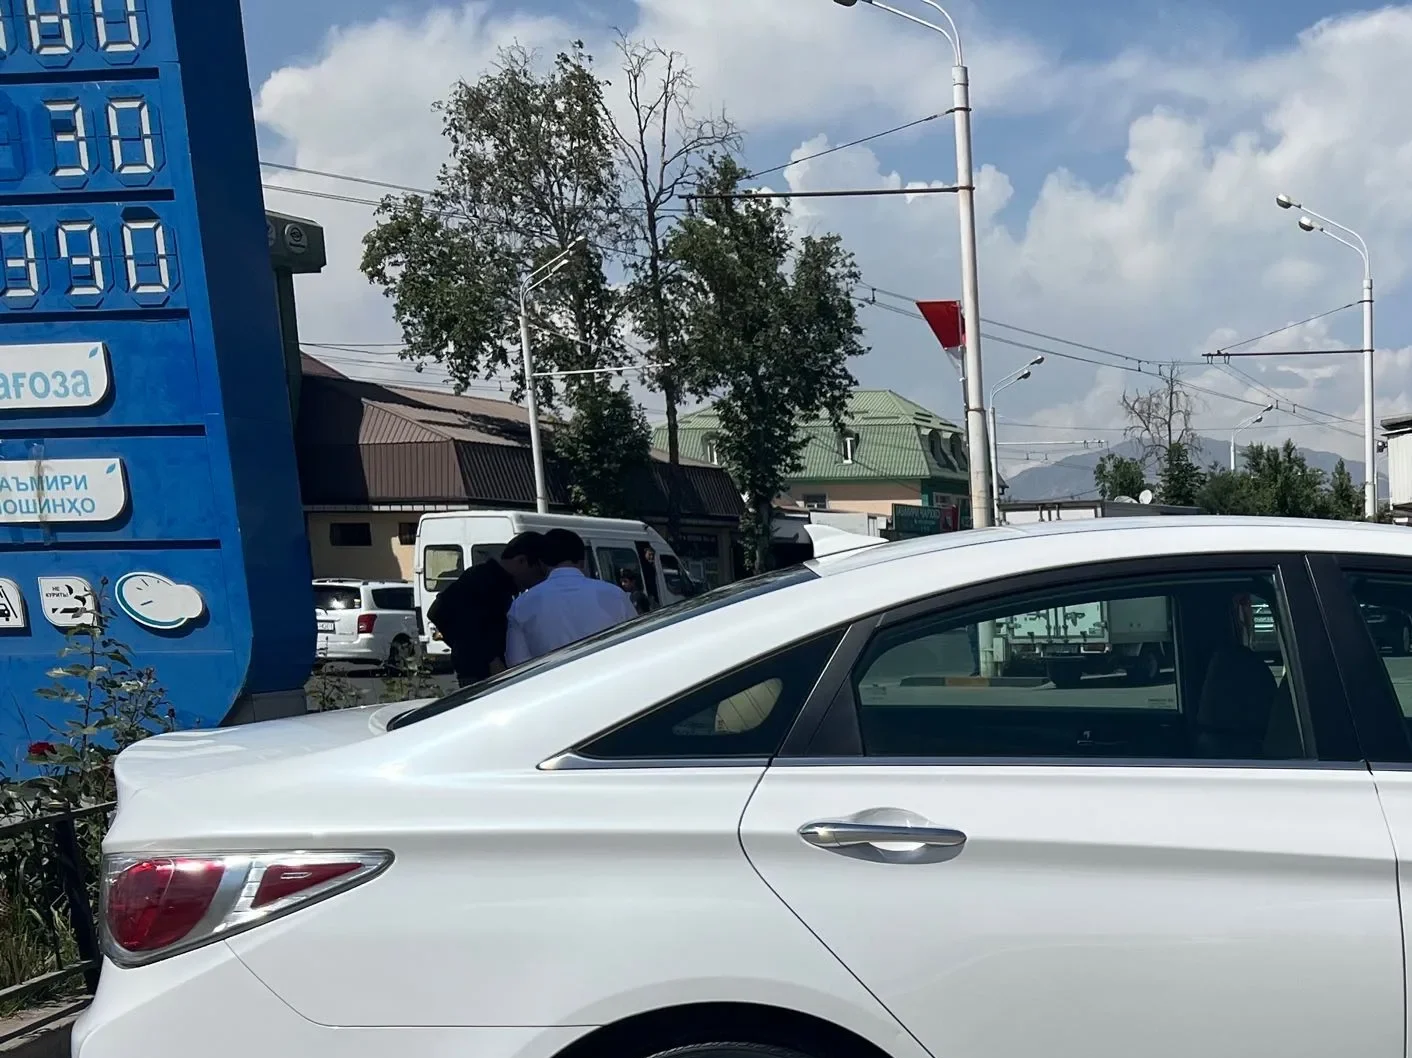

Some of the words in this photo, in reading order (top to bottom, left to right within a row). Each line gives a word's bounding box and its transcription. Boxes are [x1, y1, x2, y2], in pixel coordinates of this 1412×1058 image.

[0, 0, 140, 55] 80
[44, 101, 156, 177] 30
[0, 497, 96, 516] ОШИНҲО
